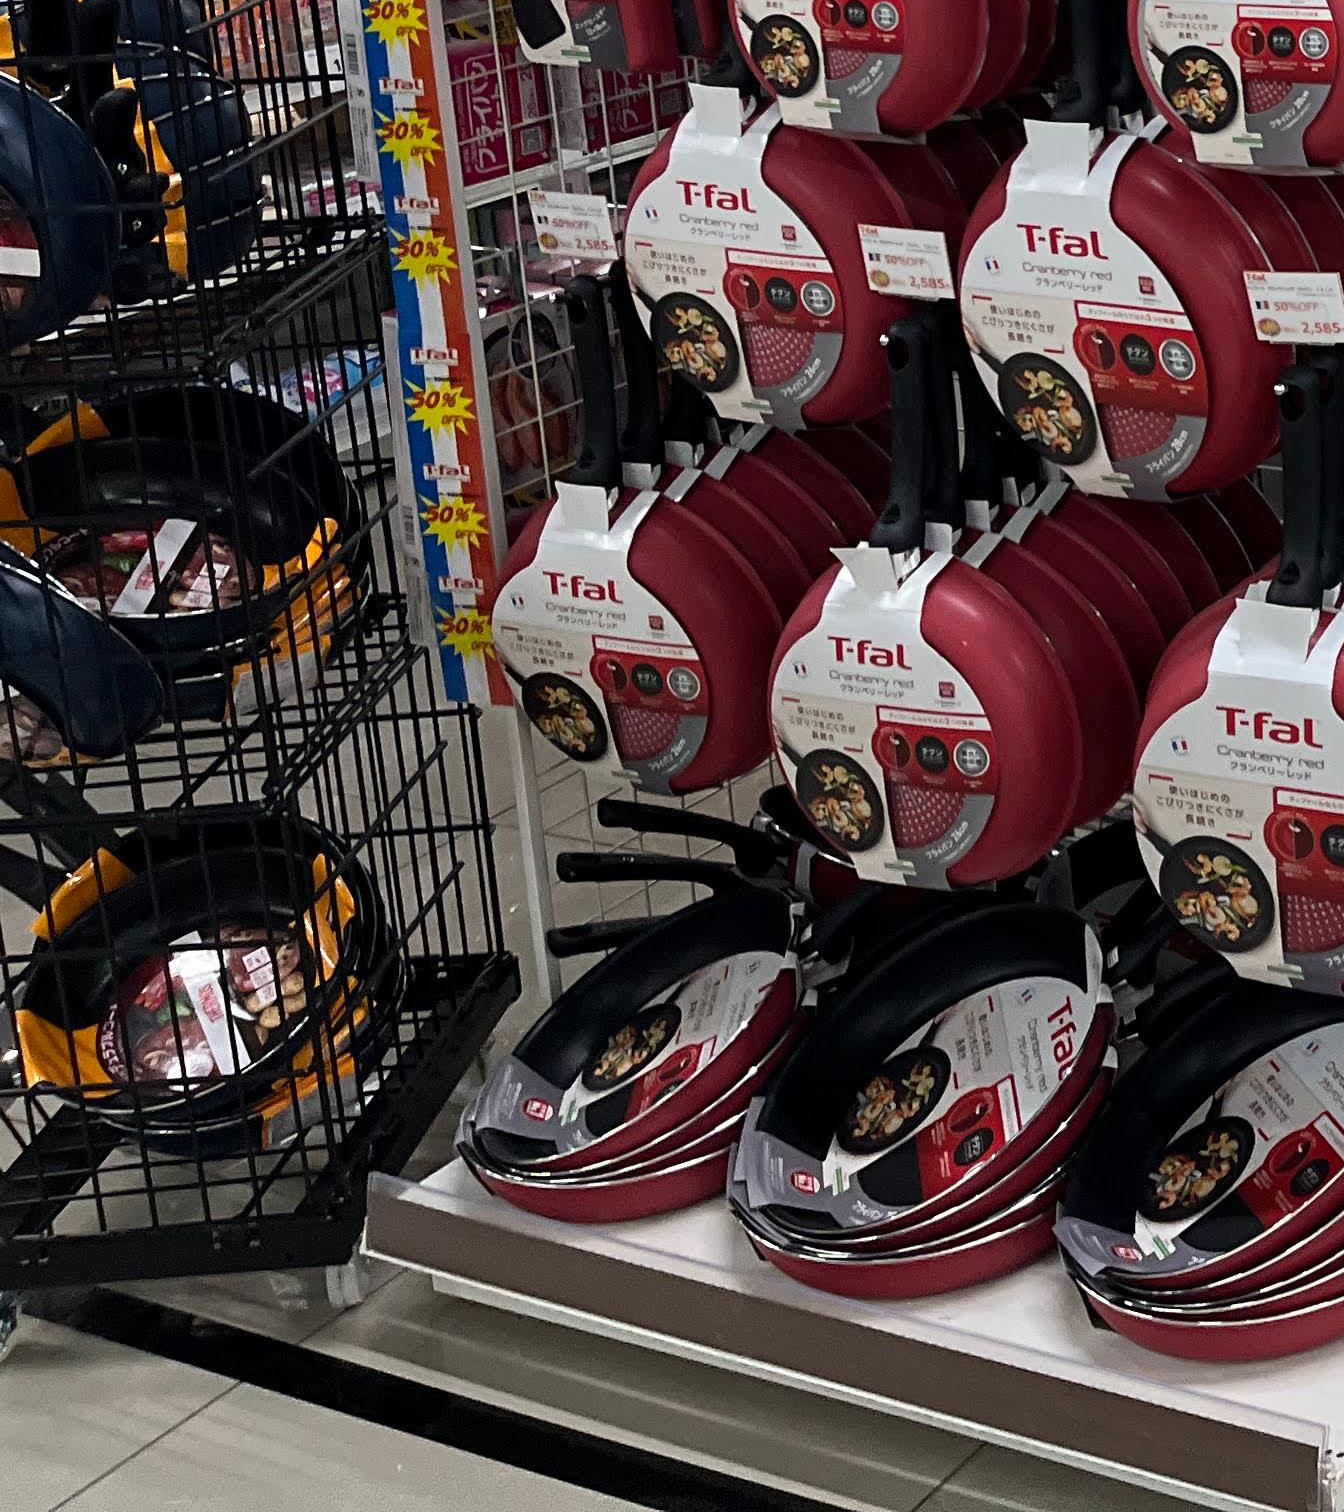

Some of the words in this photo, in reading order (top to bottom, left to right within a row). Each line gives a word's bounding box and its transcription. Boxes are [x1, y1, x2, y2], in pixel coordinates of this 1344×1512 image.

[676, 181, 756, 213] T-fal
[679, 214, 736, 230] Cranberry
[740, 220, 759, 231] red
[1017, 224, 1109, 259] T-fal
[1022, 262, 1086, 280] Cranberry
[1091, 270, 1112, 280] red
[1275, 302, 1319, 312] 50%OFF
[1301, 322, 1341, 334] 2,585
[440, 578, 482, 591] T-fal
[543, 571, 623, 604] T-fal
[545, 602, 603, 619] Cranberry
[443, 618, 484, 635] 50%
[828, 637, 912, 670] T-fal
[829, 670, 889, 686] Cranberry
[893, 678, 914, 688] red
[1216, 706, 1322, 748] T-fal
[1217, 744, 1294, 766] Cranberry
[1298, 758, 1324, 770] red
[1230, 761, 1312, 780] クランベリーレッド
